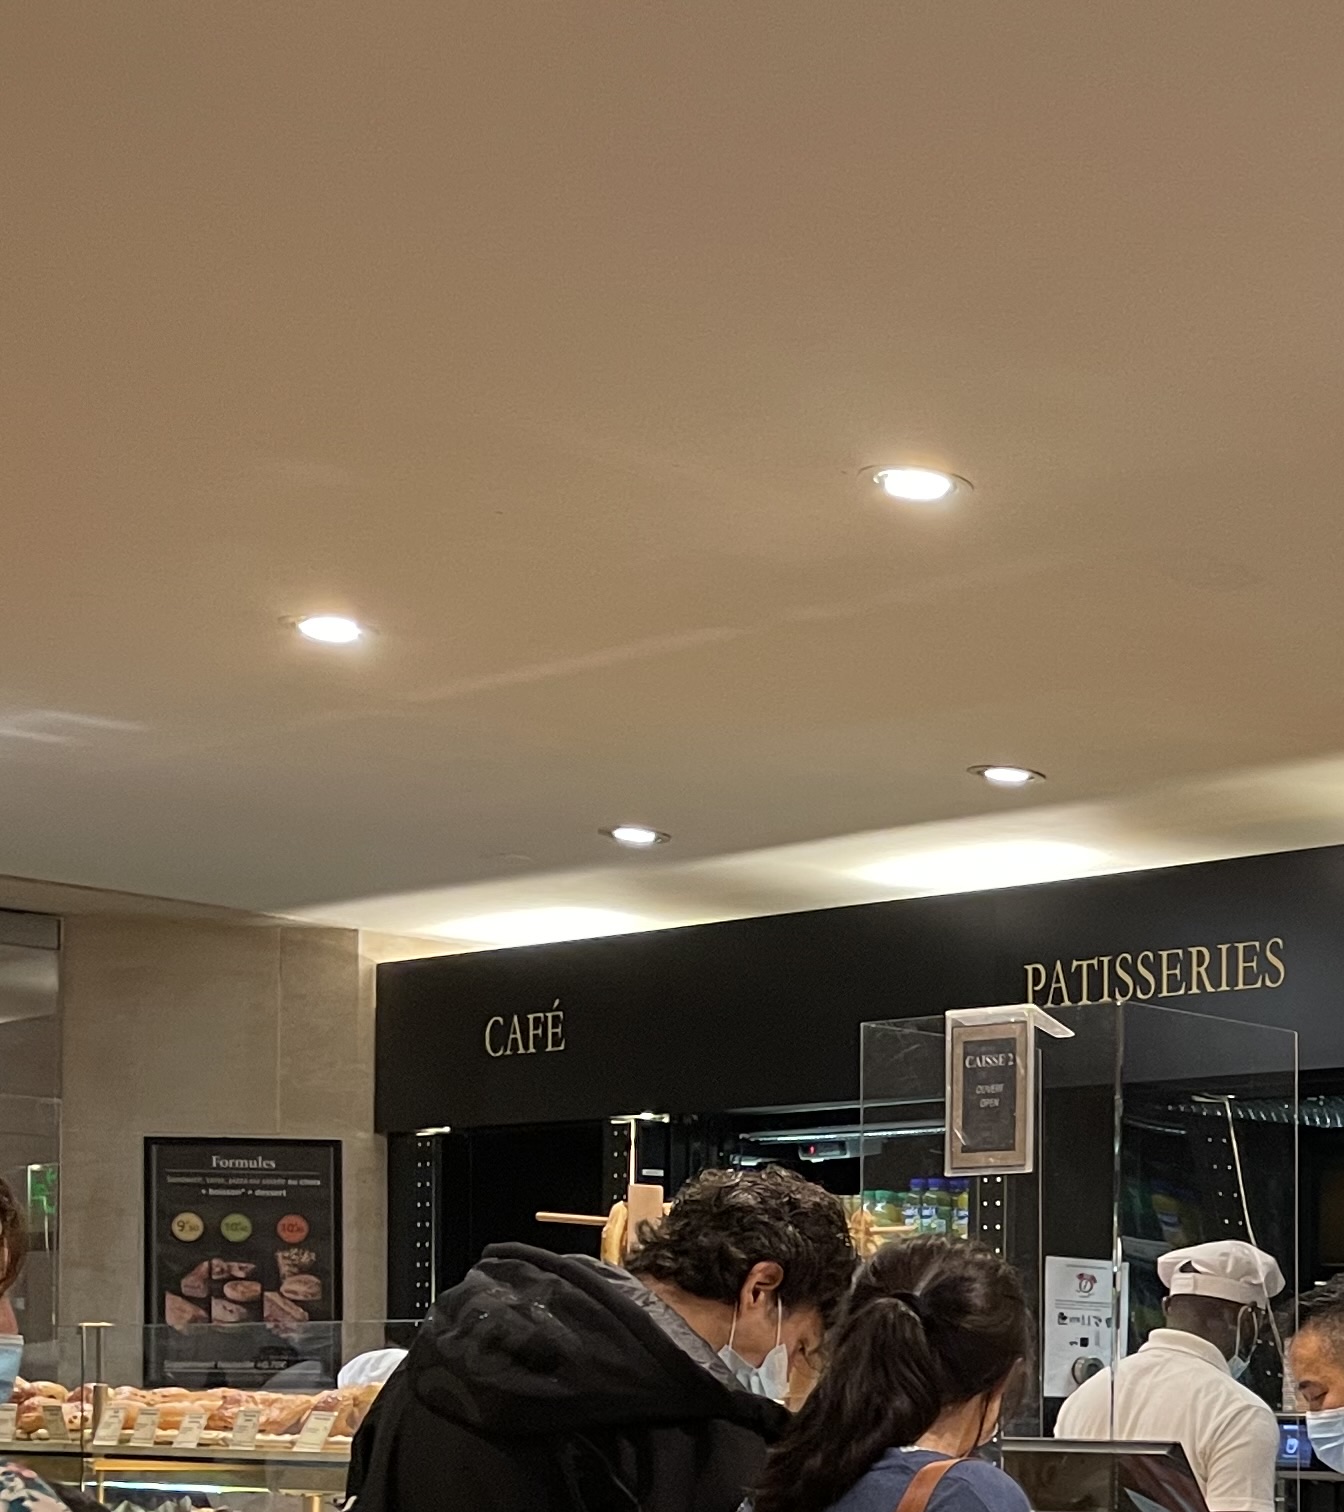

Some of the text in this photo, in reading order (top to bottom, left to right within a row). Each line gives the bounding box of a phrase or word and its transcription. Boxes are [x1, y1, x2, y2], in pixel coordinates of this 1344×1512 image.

[1024, 937, 1286, 1008] PATISSERIES
[484, 998, 566, 1057] CAFÉ
[965, 1053, 1015, 1068] CAISSE 2
[211, 1156, 277, 1169] Formules
